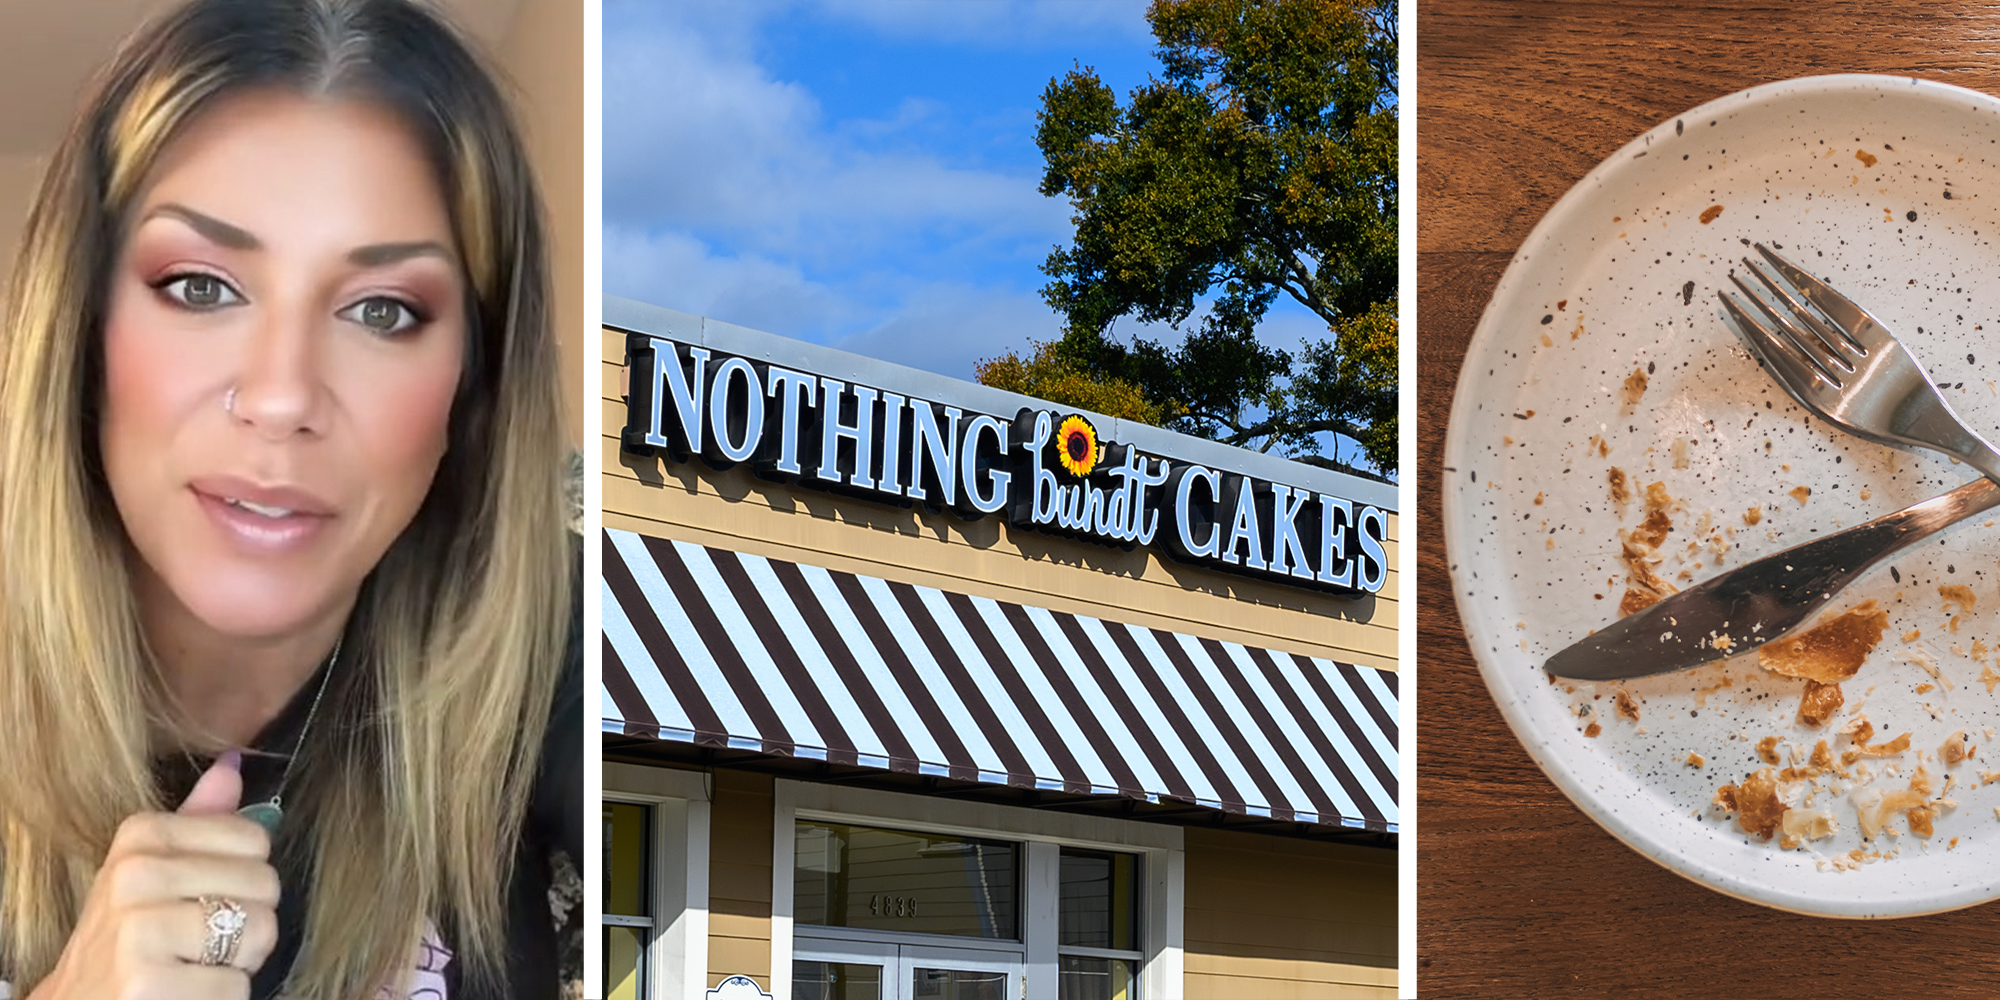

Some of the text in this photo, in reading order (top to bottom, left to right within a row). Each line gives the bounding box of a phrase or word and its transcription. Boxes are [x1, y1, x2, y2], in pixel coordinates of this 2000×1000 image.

[645, 338, 1388, 593] NOTHING bundt CAKES
[869, 894, 918, 918] 4839
